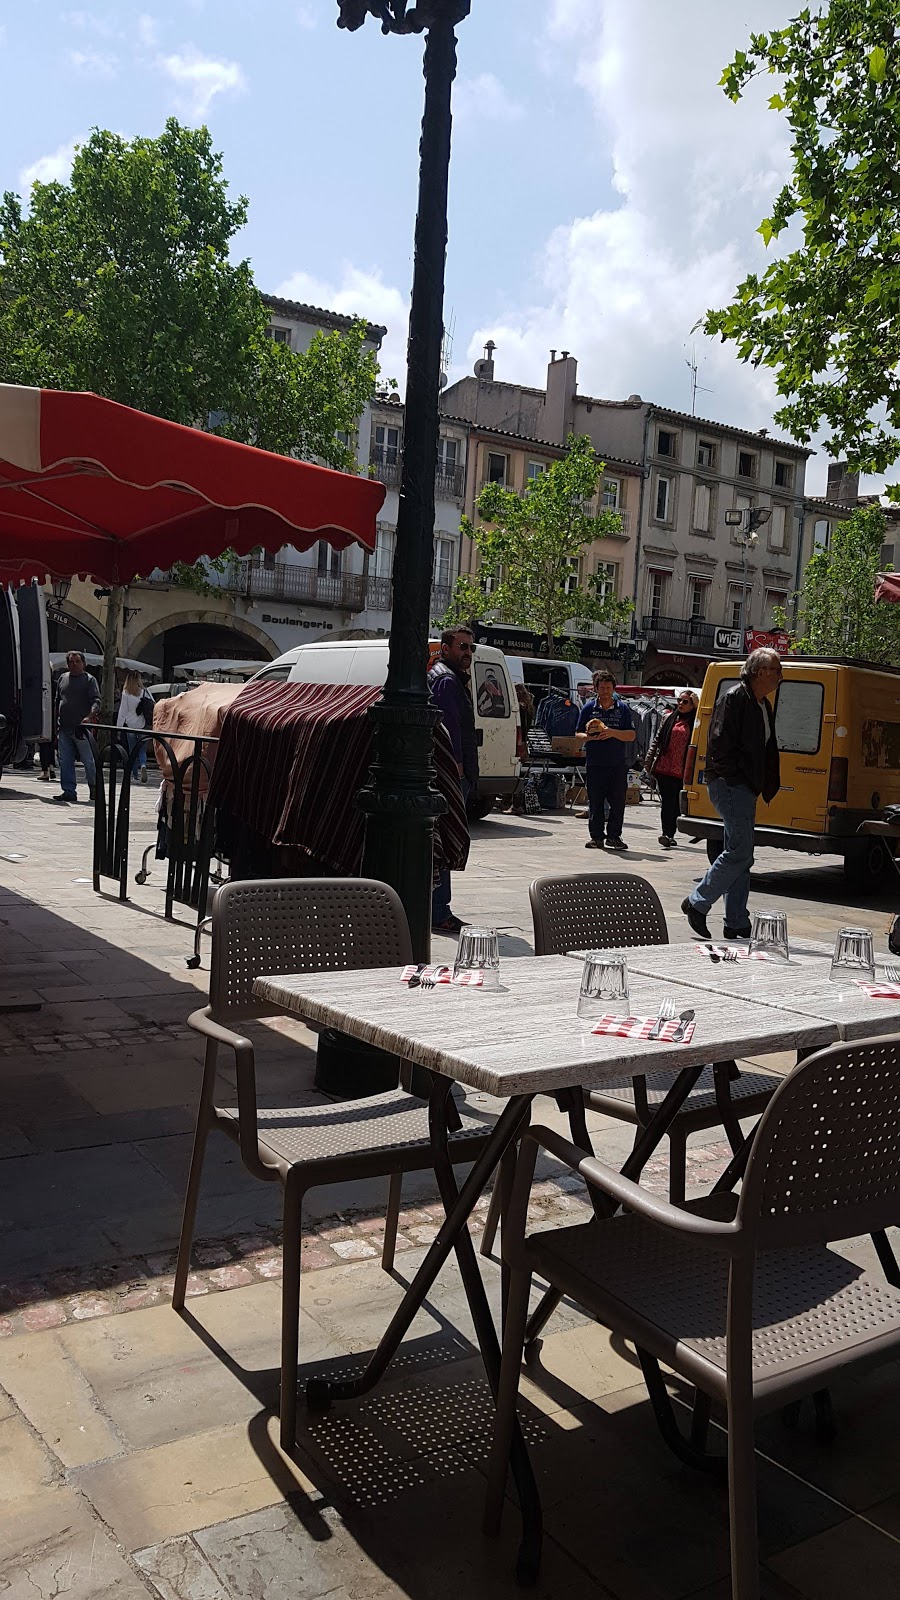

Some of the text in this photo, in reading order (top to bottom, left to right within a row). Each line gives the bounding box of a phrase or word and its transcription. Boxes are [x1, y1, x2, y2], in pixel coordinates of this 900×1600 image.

[53, 613, 69, 624] FILS
[262, 614, 333, 630] Boulangerie
[493, 638, 505, 646] BAR
[507, 640, 534, 650] BRASSERIE
[589, 649, 612, 658] PIZZERIA
